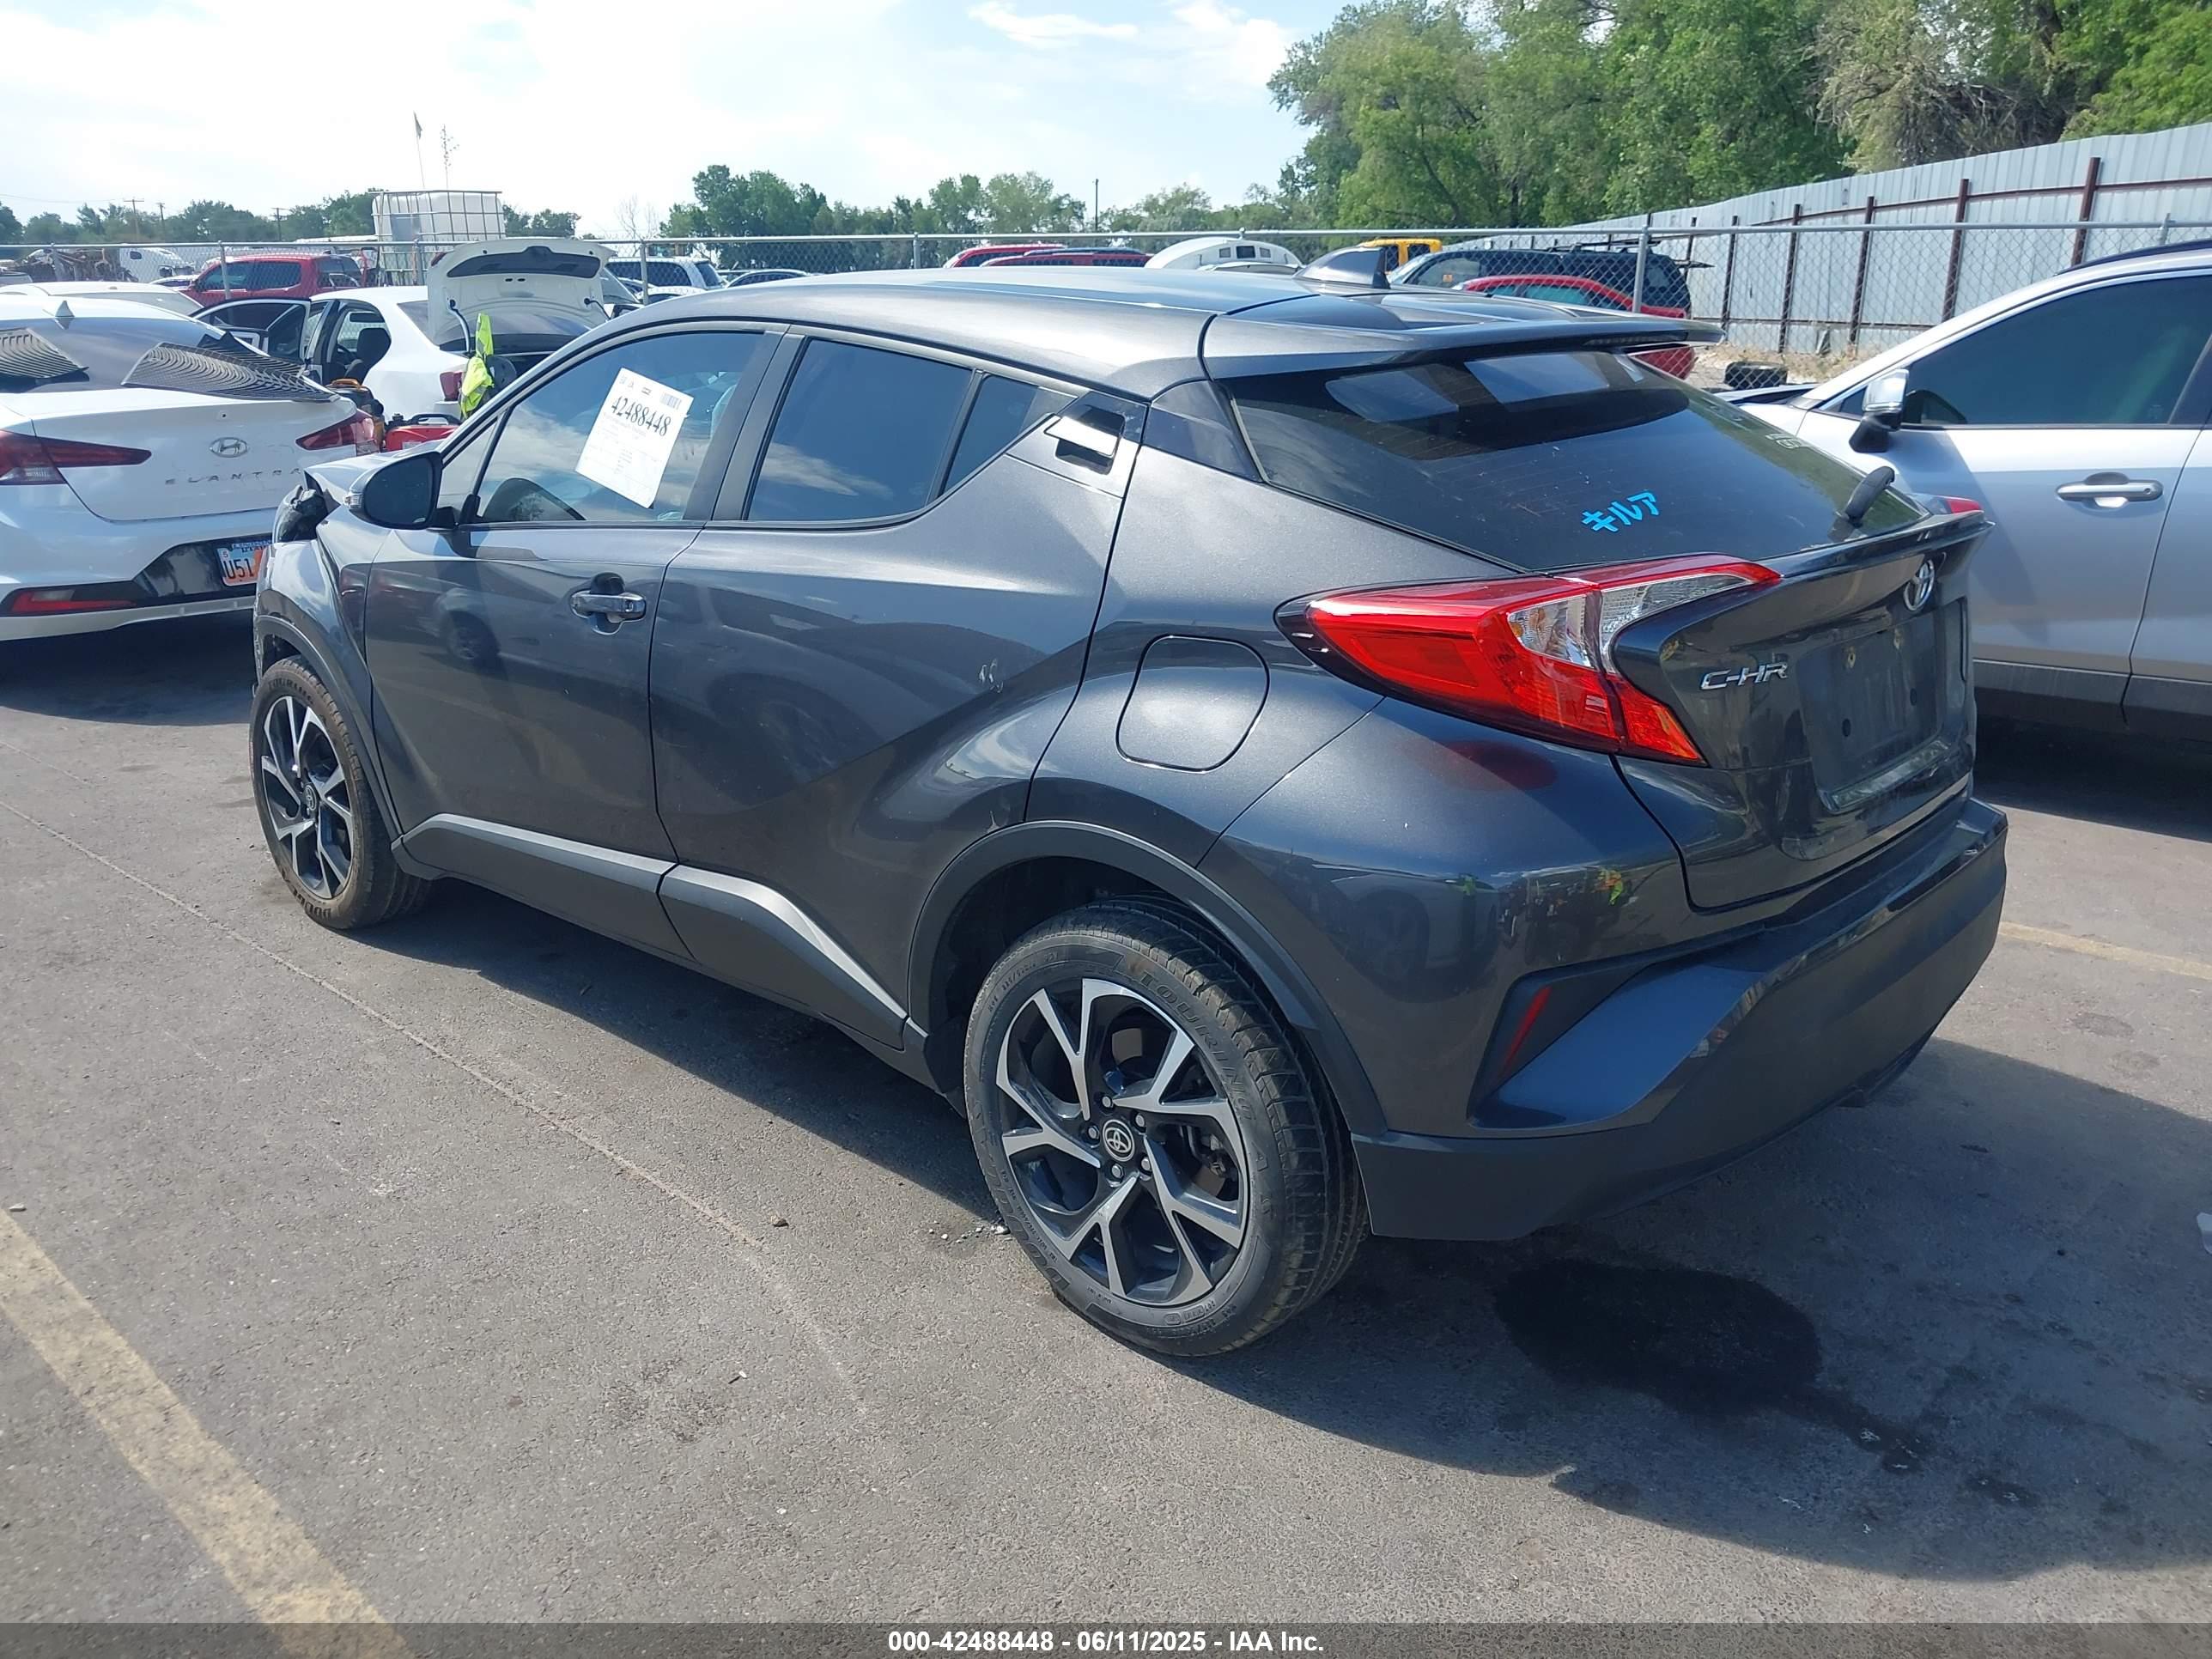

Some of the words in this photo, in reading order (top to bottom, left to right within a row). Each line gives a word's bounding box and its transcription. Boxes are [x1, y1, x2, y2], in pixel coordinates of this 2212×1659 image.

[611, 395, 672, 437] 42488448
[164, 467, 302, 485] ELANTRA
[1581, 491, 1660, 532] キルア
[1699, 661, 1789, 690] C-HR
